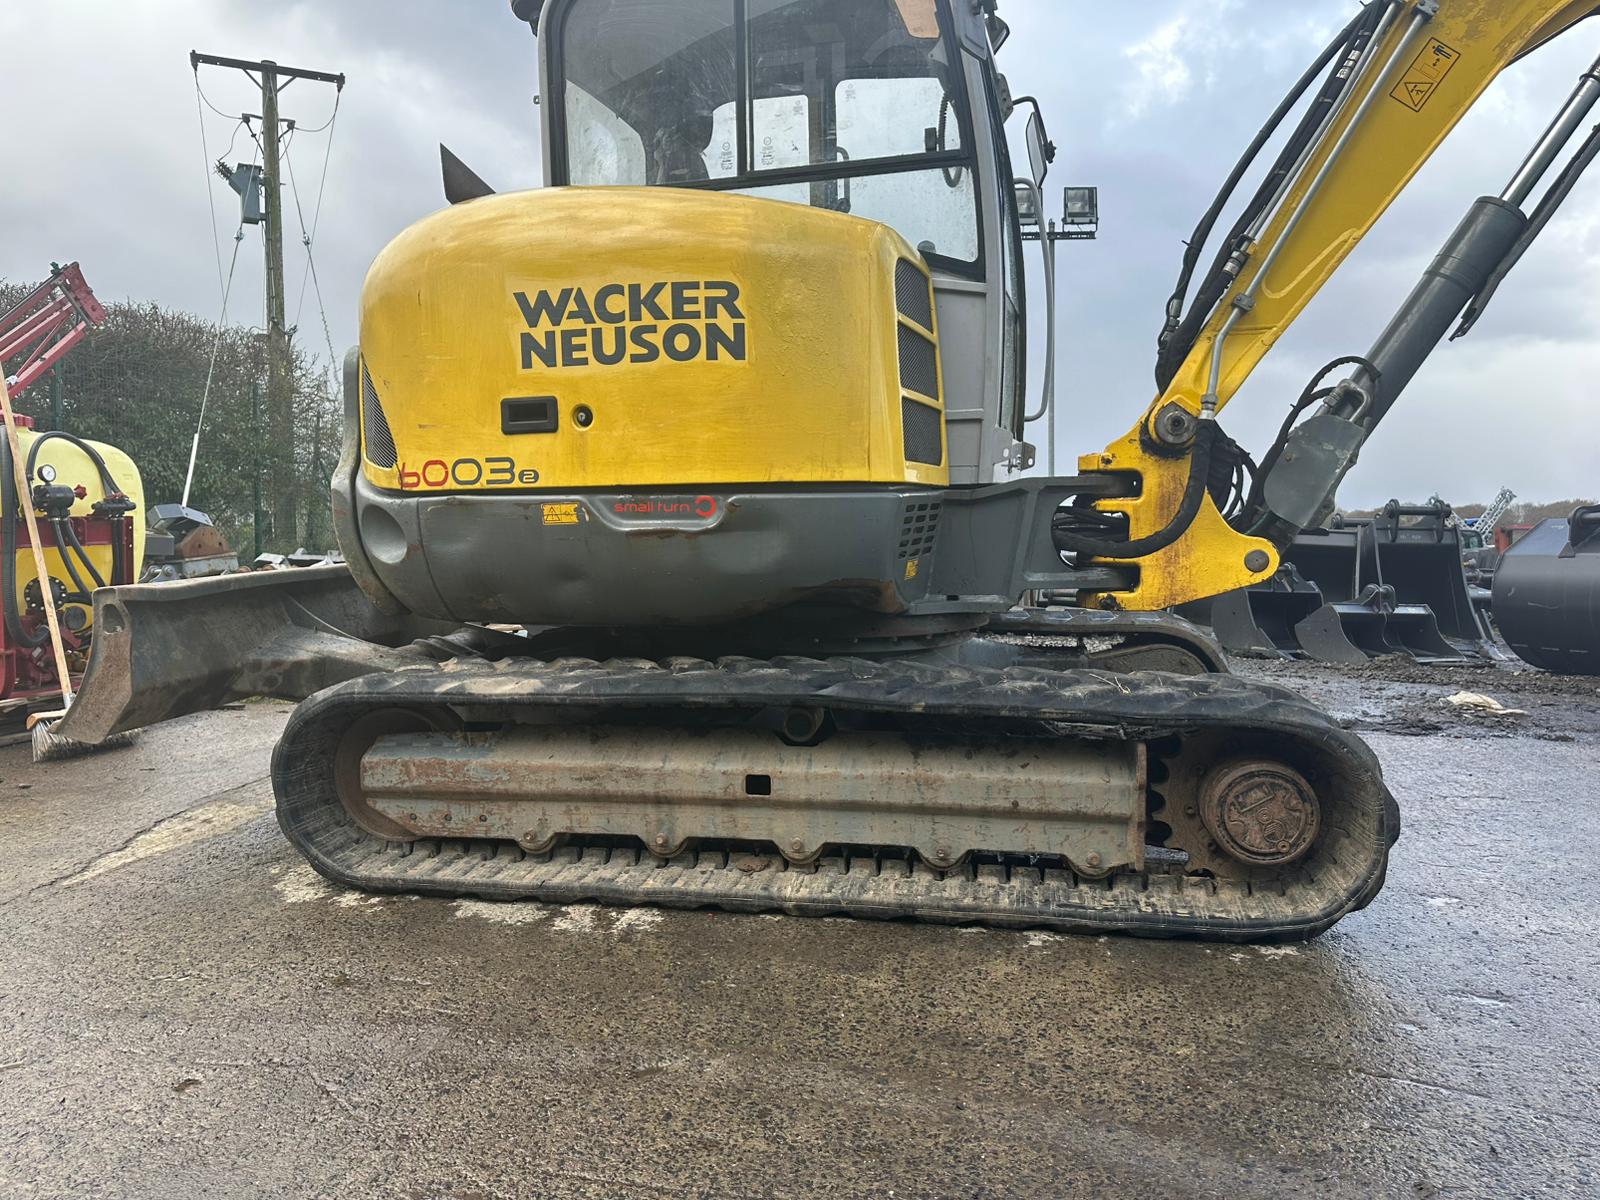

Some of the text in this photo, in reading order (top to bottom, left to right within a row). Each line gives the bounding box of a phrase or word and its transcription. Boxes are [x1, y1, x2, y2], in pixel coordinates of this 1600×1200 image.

[513, 281, 746, 328] WACKER
[520, 323, 746, 369] NEUSON
[400, 457, 515, 488] 6003
[614, 500, 692, 513] small turn
